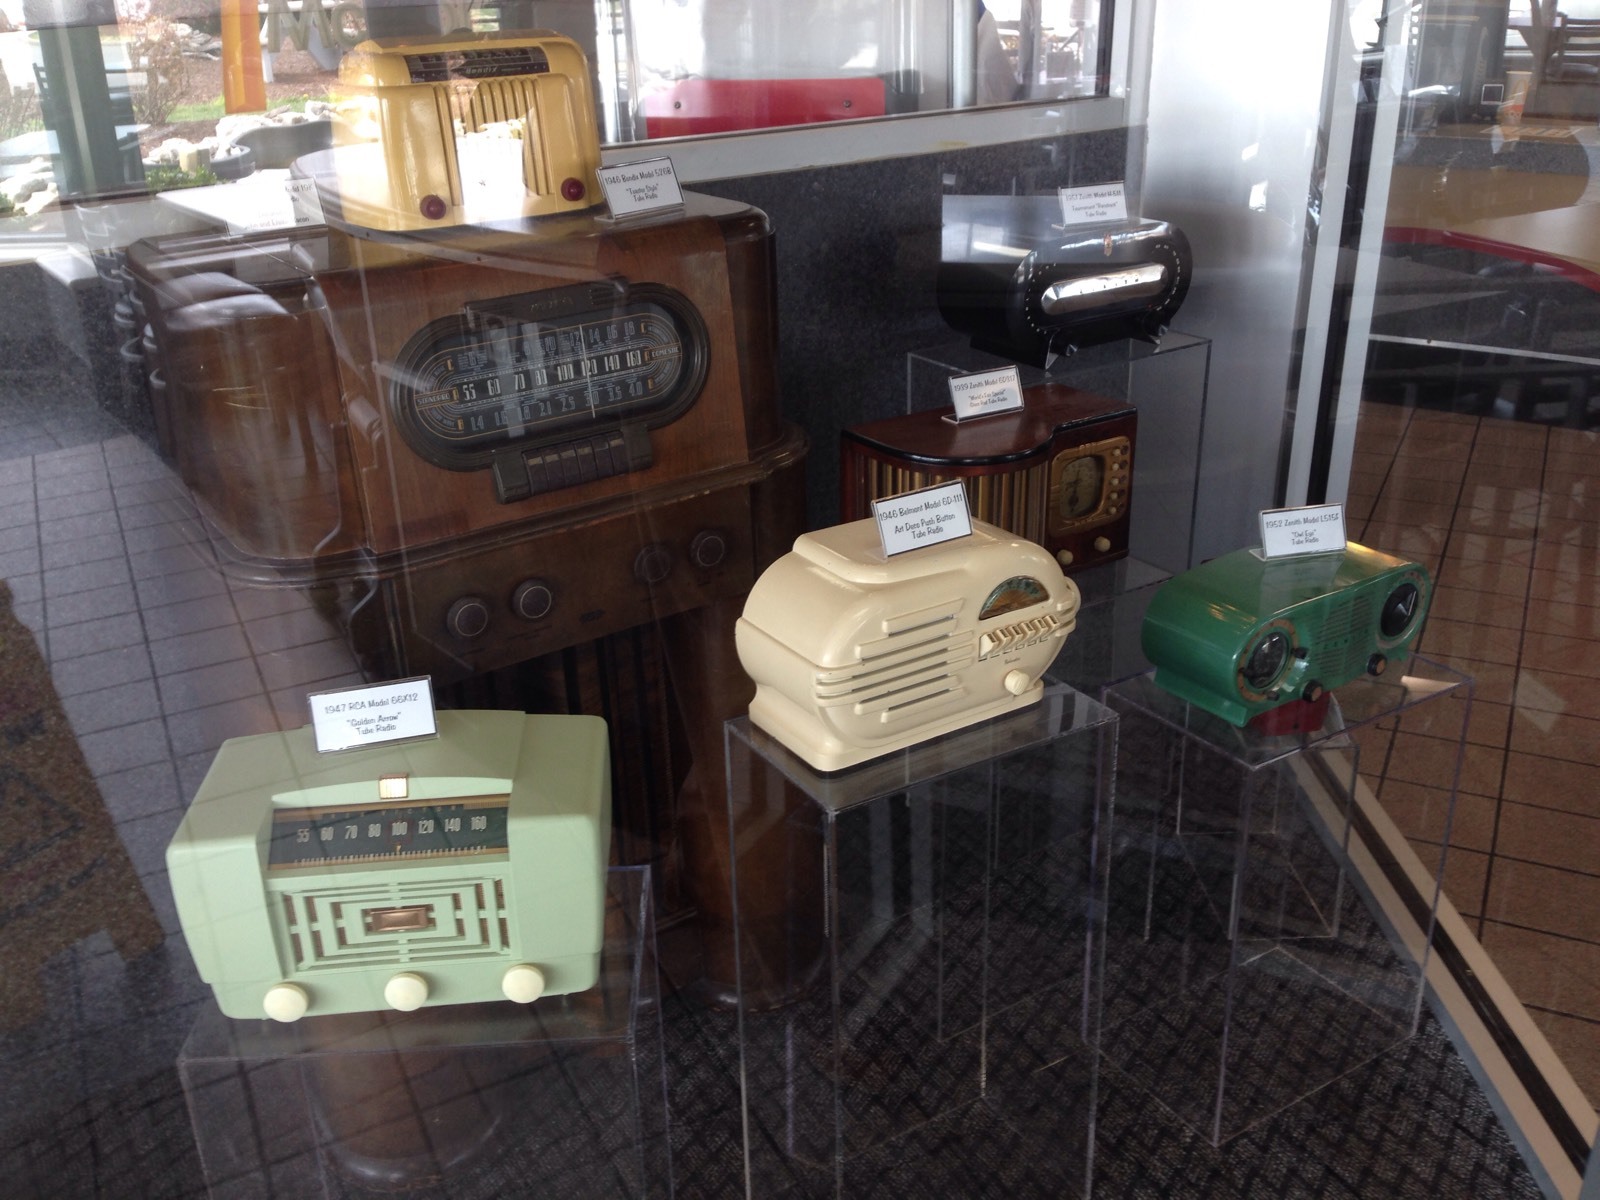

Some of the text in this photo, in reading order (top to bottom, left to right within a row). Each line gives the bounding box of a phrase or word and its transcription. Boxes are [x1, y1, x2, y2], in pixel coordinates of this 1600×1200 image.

[604, 176, 622, 185] 1946
[640, 170, 655, 180] Model
[462, 384, 477, 400] 55
[487, 378, 501, 396] 60
[514, 373, 526, 391] 70
[534, 369, 548, 386] 80
[557, 363, 575, 382] 100
[581, 359, 598, 376] 120
[604, 354, 620, 372] 140
[626, 350, 641, 367] 160
[954, 384, 969, 392] 1939
[969, 381, 985, 390] Zenith
[984, 378, 999, 387] Model
[880, 510, 898, 521] 1946
[898, 505, 923, 517] Belmont
[924, 501, 941, 511] Model
[894, 513, 956, 535] Art Deco Push Button
[1265, 520, 1283, 529] 1952
[1284, 518, 1302, 527] Zenith
[1303, 516, 1320, 525] Model
[911, 526, 944, 539] Tube Radio
[1291, 536, 1320, 546] Tube Radio
[324, 703, 347, 715] 1947
[348, 701, 367, 711] RCA
[368, 698, 390, 708] Model
[356, 724, 397, 736] Tube Radio
[296, 815, 487, 844] 55 60 70 80 100 120 140 160
